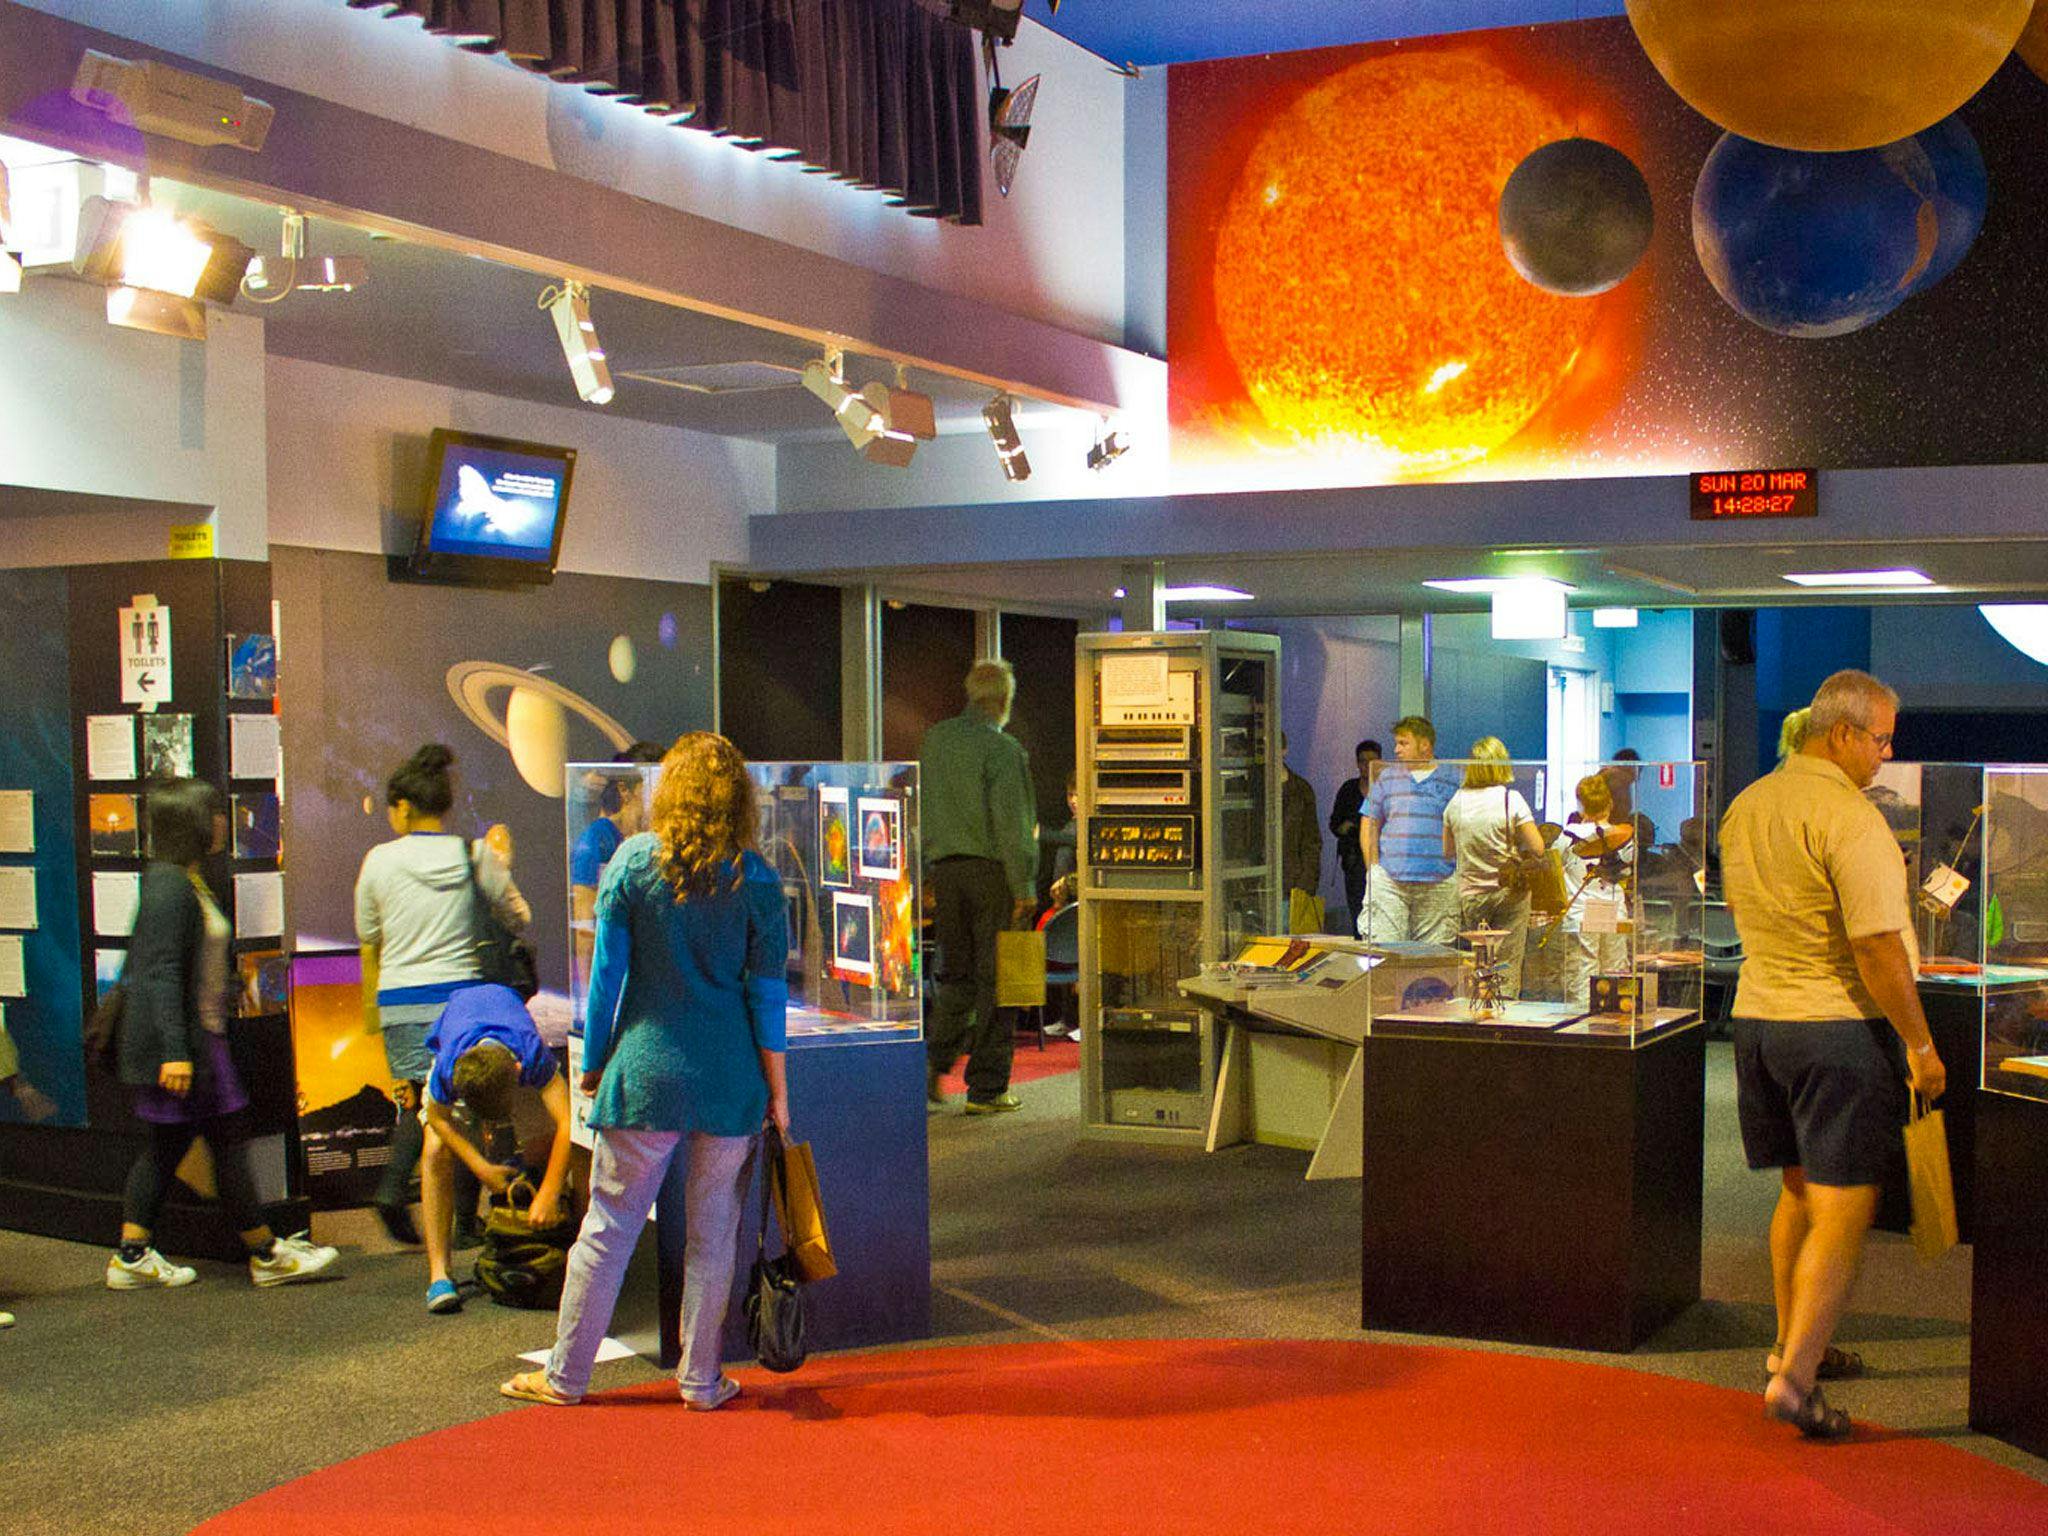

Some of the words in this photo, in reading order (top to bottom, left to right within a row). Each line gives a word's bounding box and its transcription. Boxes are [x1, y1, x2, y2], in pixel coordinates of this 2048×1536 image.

[1700, 475, 1736, 493] SUN
[1740, 474, 1765, 491] 20
[1770, 471, 1807, 490] MAR
[1713, 494, 1794, 514] 14:28:27
[128, 657, 166, 668] TOILETS
